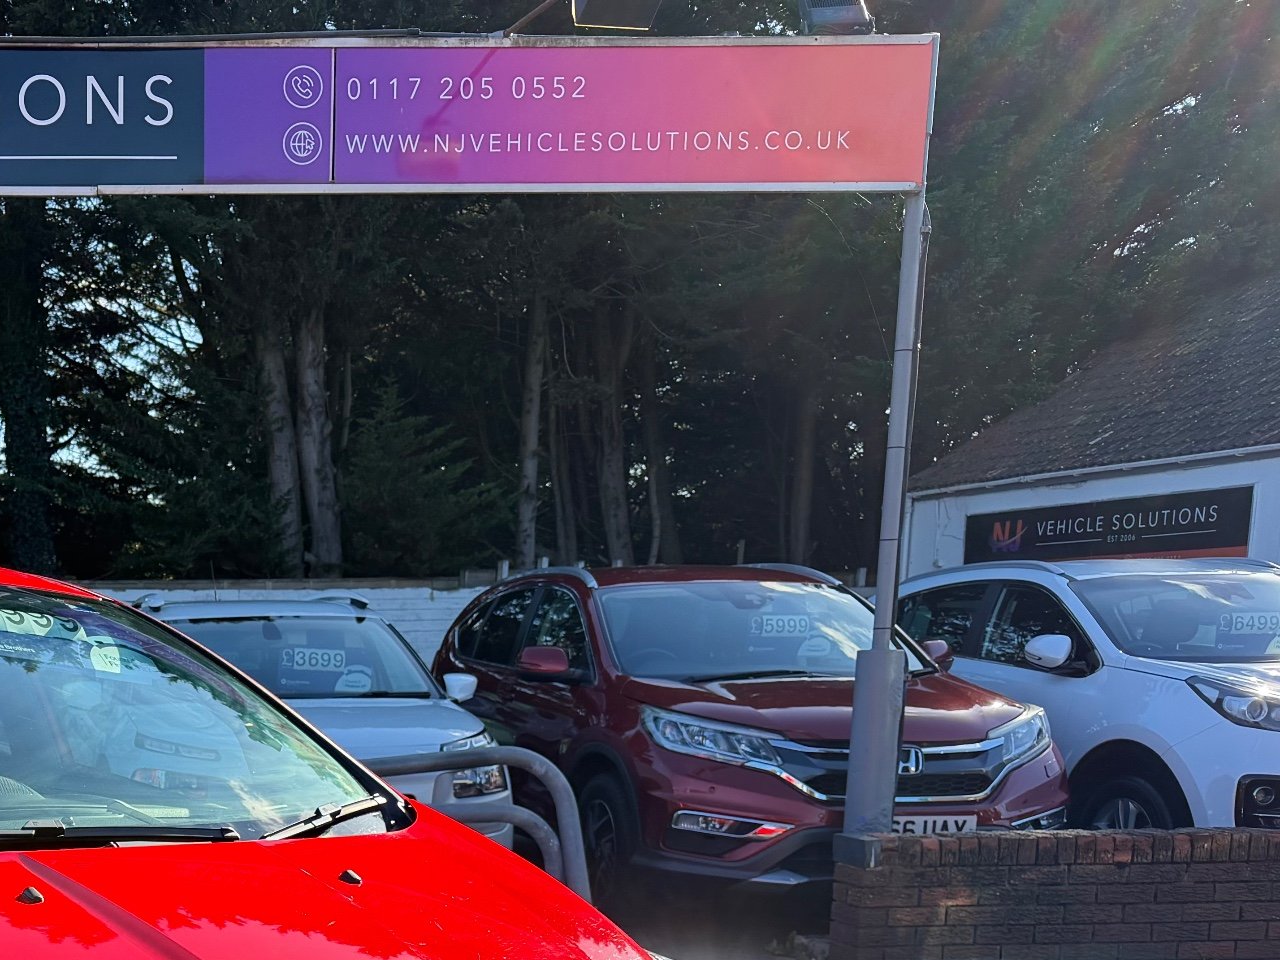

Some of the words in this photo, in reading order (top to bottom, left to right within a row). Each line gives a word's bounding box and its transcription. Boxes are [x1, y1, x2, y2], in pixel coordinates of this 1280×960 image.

[347, 77, 421, 100] 0117
[439, 77, 494, 99] 205
[512, 76, 586, 98] 0552
[346, 131, 851, 153] WWW.NJVEHICLESOLUTIONS.CO.UK
[1037, 515, 1104, 536] VEHICLE
[1112, 505, 1218, 530] SOLUTIONS
[991, 520, 1024, 552] NJ
[1107, 535, 1118, 543] EST
[1120, 534, 1136, 542] 2006
[750, 616, 808, 634] £5999
[1220, 614, 1280, 631] £6499
[281, 648, 344, 668] £3699
